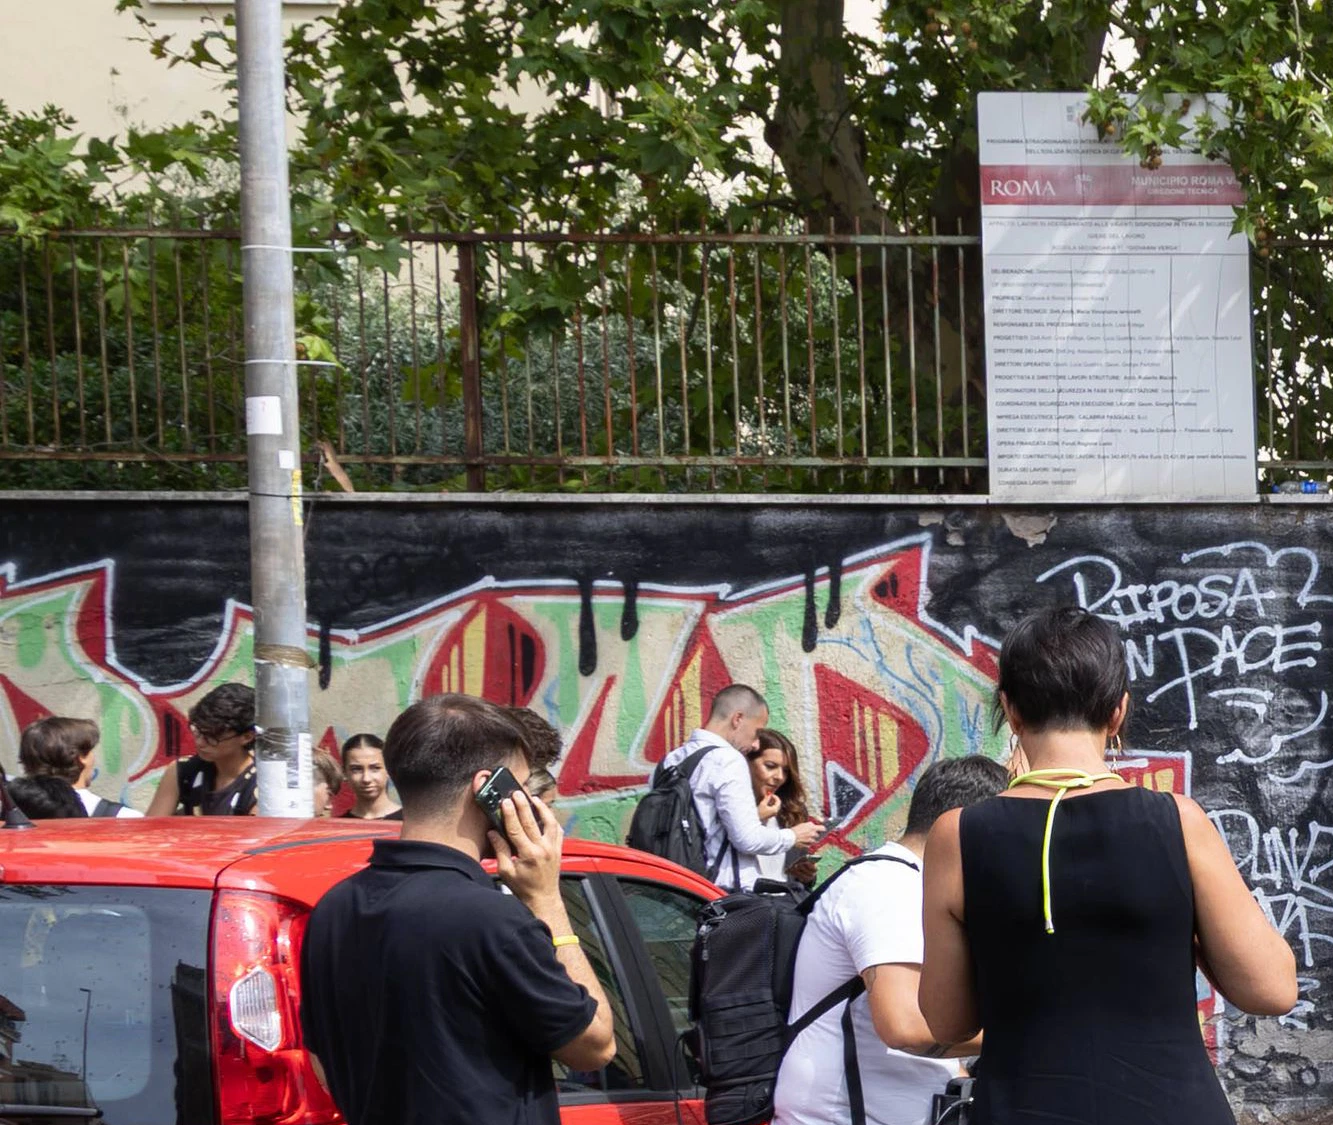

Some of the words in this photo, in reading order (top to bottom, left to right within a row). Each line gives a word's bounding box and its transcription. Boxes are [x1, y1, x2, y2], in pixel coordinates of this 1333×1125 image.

[990, 179, 1056, 196] ROMA
[1131, 175, 1188, 186] MUNICIPIO
[1191, 175, 1224, 186] ROMA
[1036, 555, 1276, 630] RIPOSA
[1147, 624, 1322, 730] PACE
